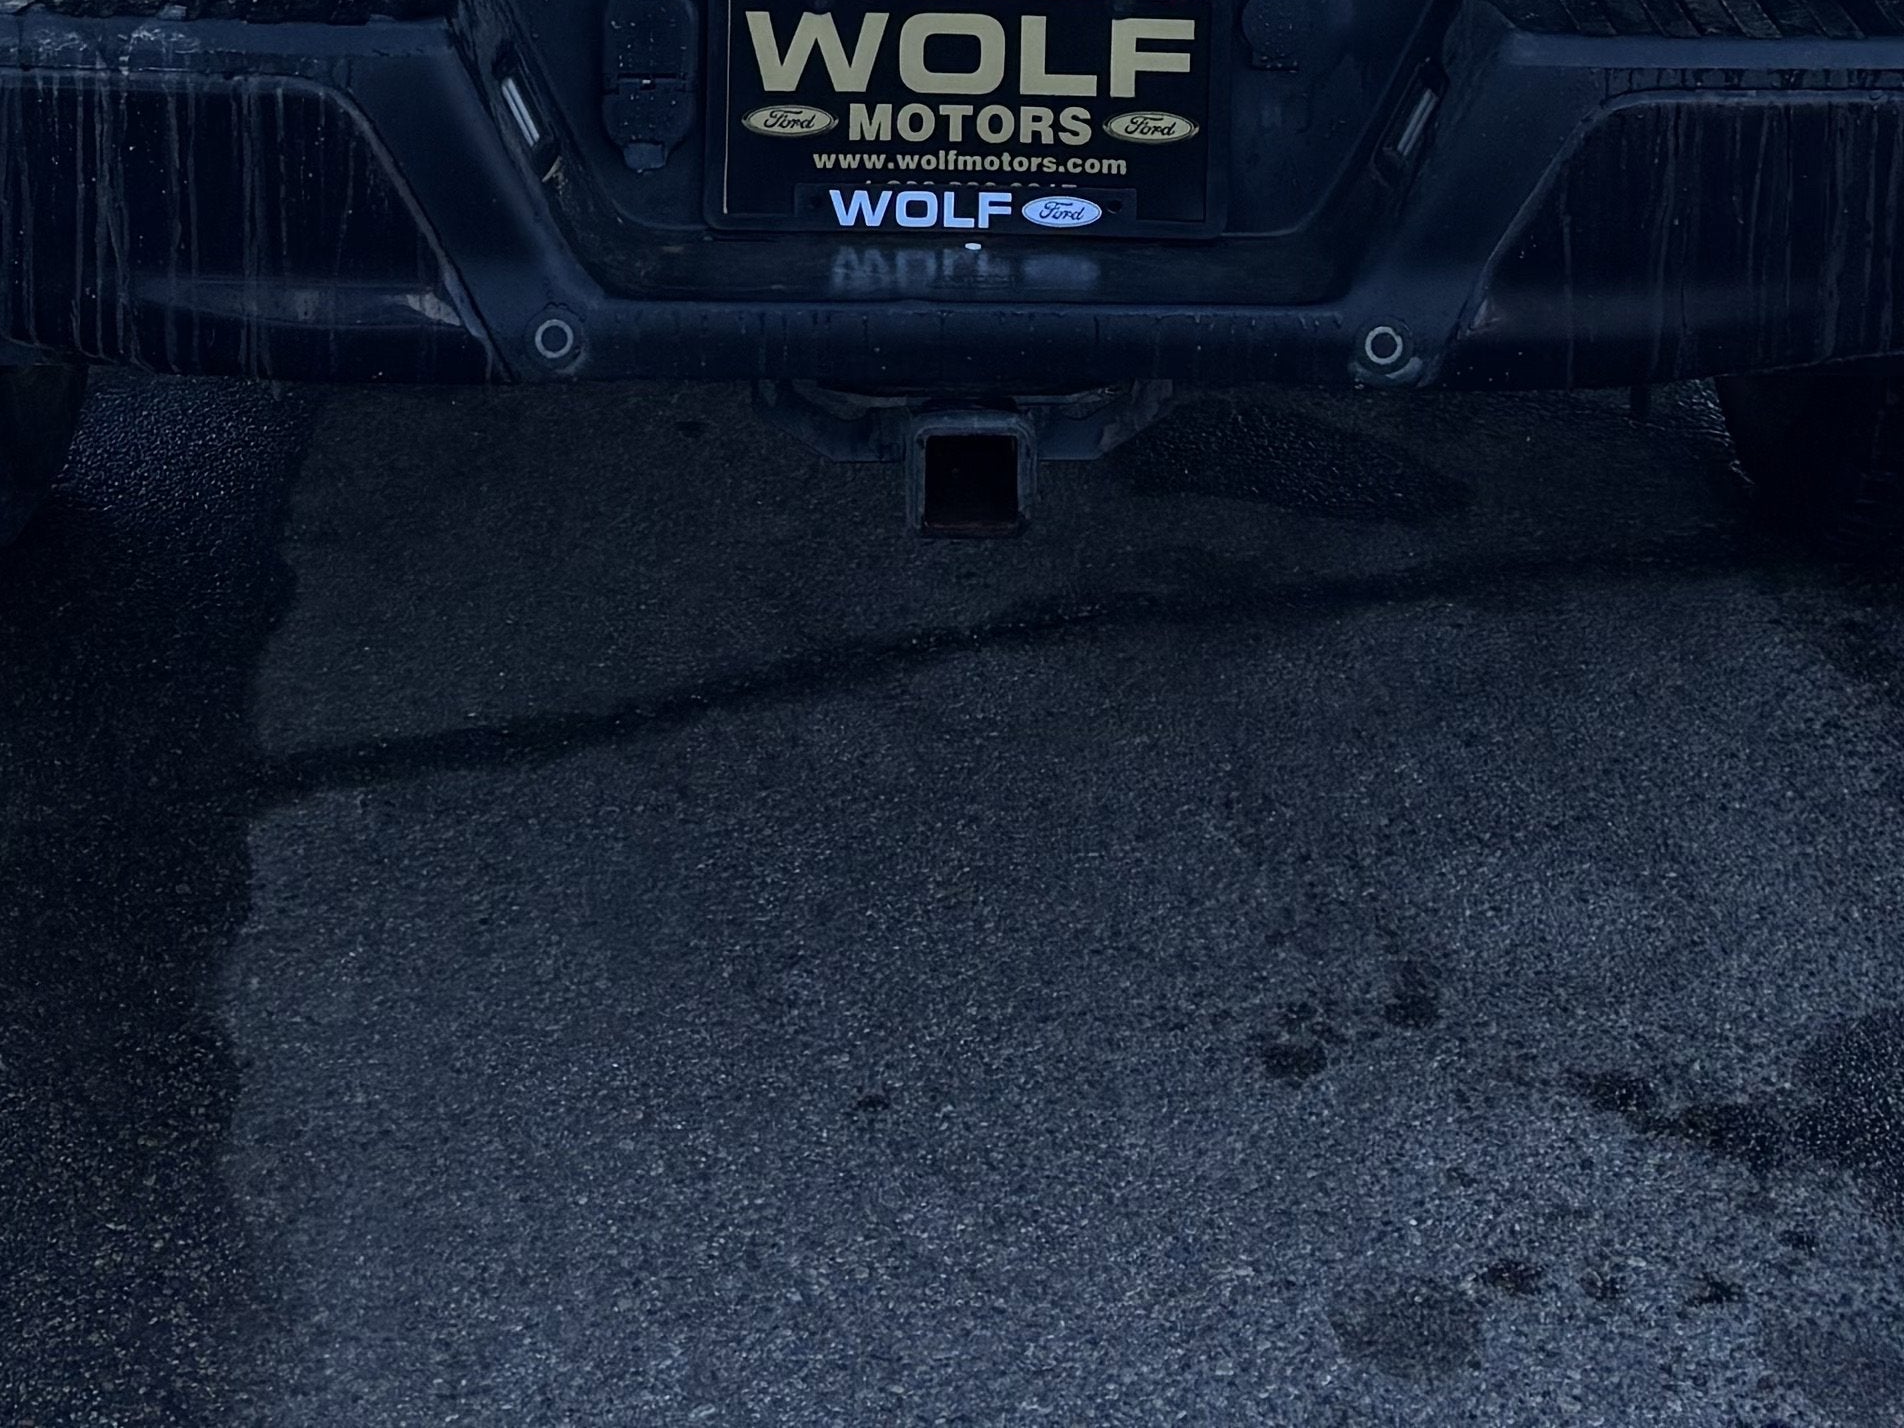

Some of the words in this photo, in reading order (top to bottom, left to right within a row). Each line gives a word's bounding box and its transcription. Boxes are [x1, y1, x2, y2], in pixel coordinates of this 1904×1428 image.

[745, 10, 1195, 98] WOLF
[849, 102, 1092, 145] MOTORS
[812, 150, 1127, 175] www.wolfmotors.com
[829, 189, 1012, 229] WOLF
